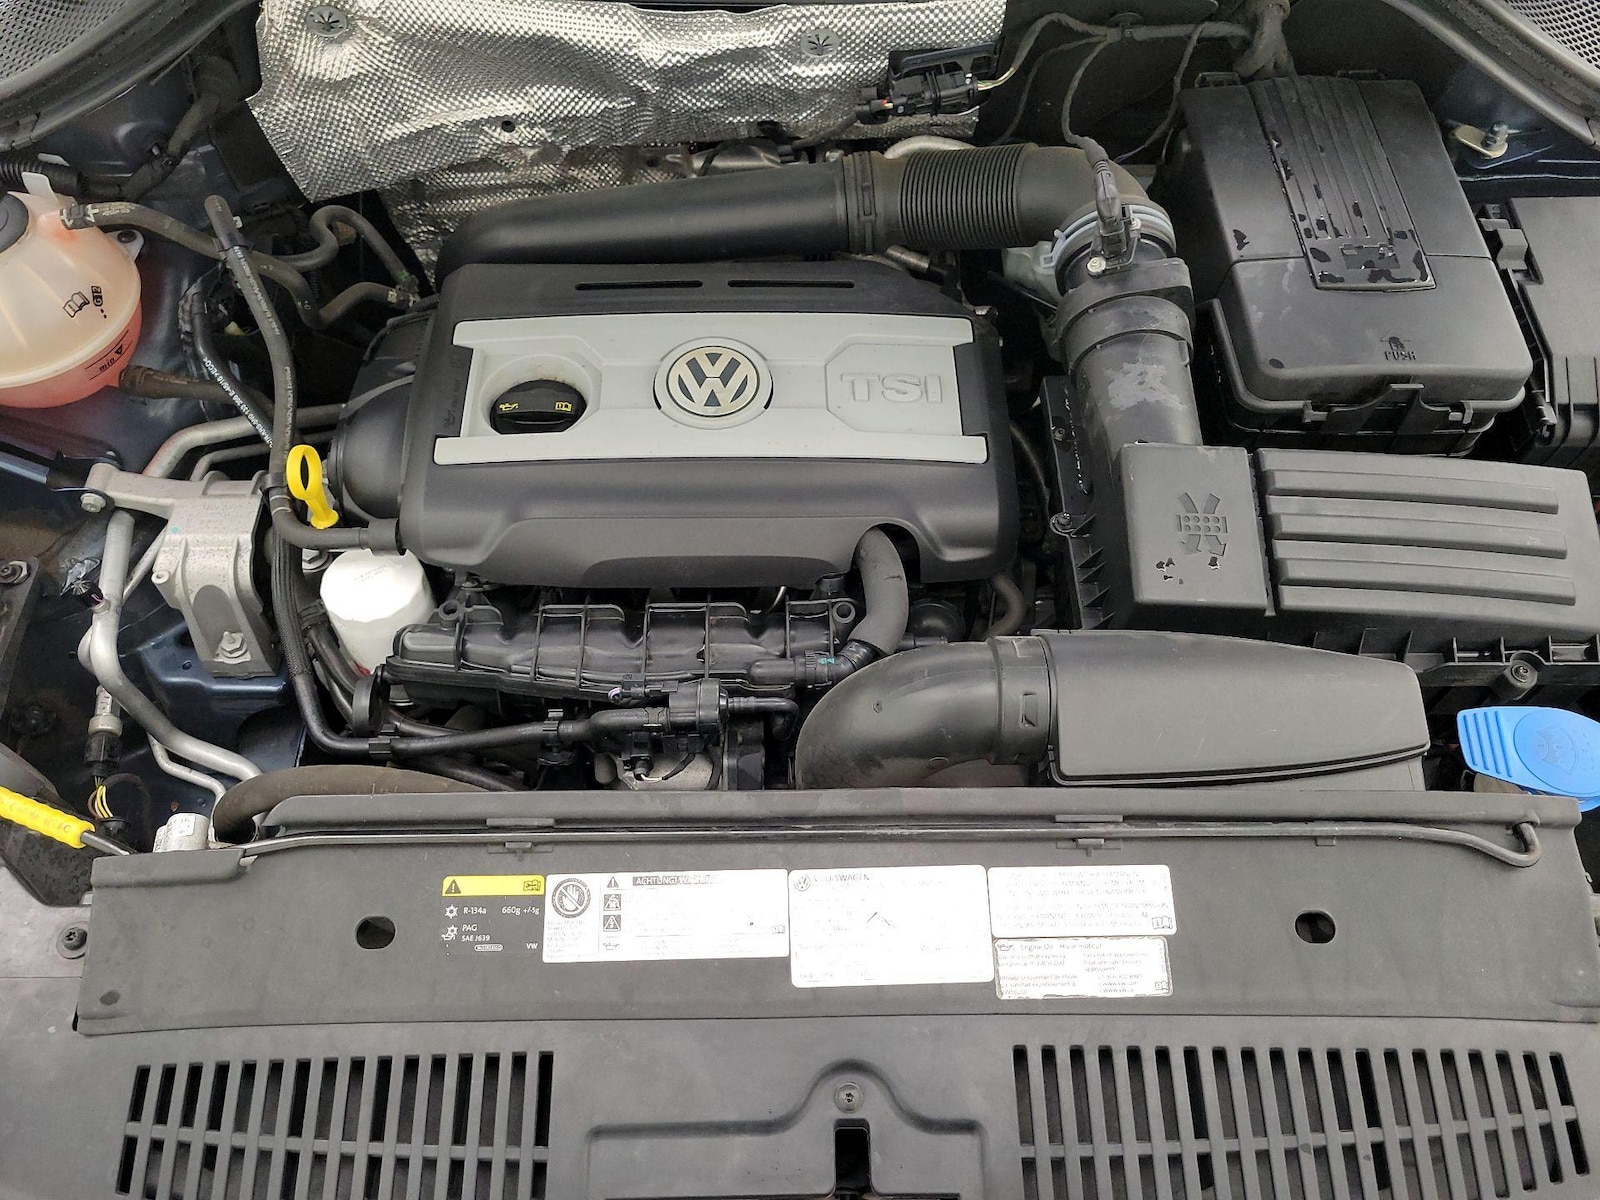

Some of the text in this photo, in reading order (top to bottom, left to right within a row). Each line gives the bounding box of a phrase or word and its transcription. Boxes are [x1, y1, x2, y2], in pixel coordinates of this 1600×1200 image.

[840, 373, 942, 403] TSI
[463, 907, 487, 915] R-134a
[501, 906, 521, 916] 660g
[462, 924, 478, 932] PAG
[475, 934, 491, 942] J639
[526, 942, 539, 950] VW
